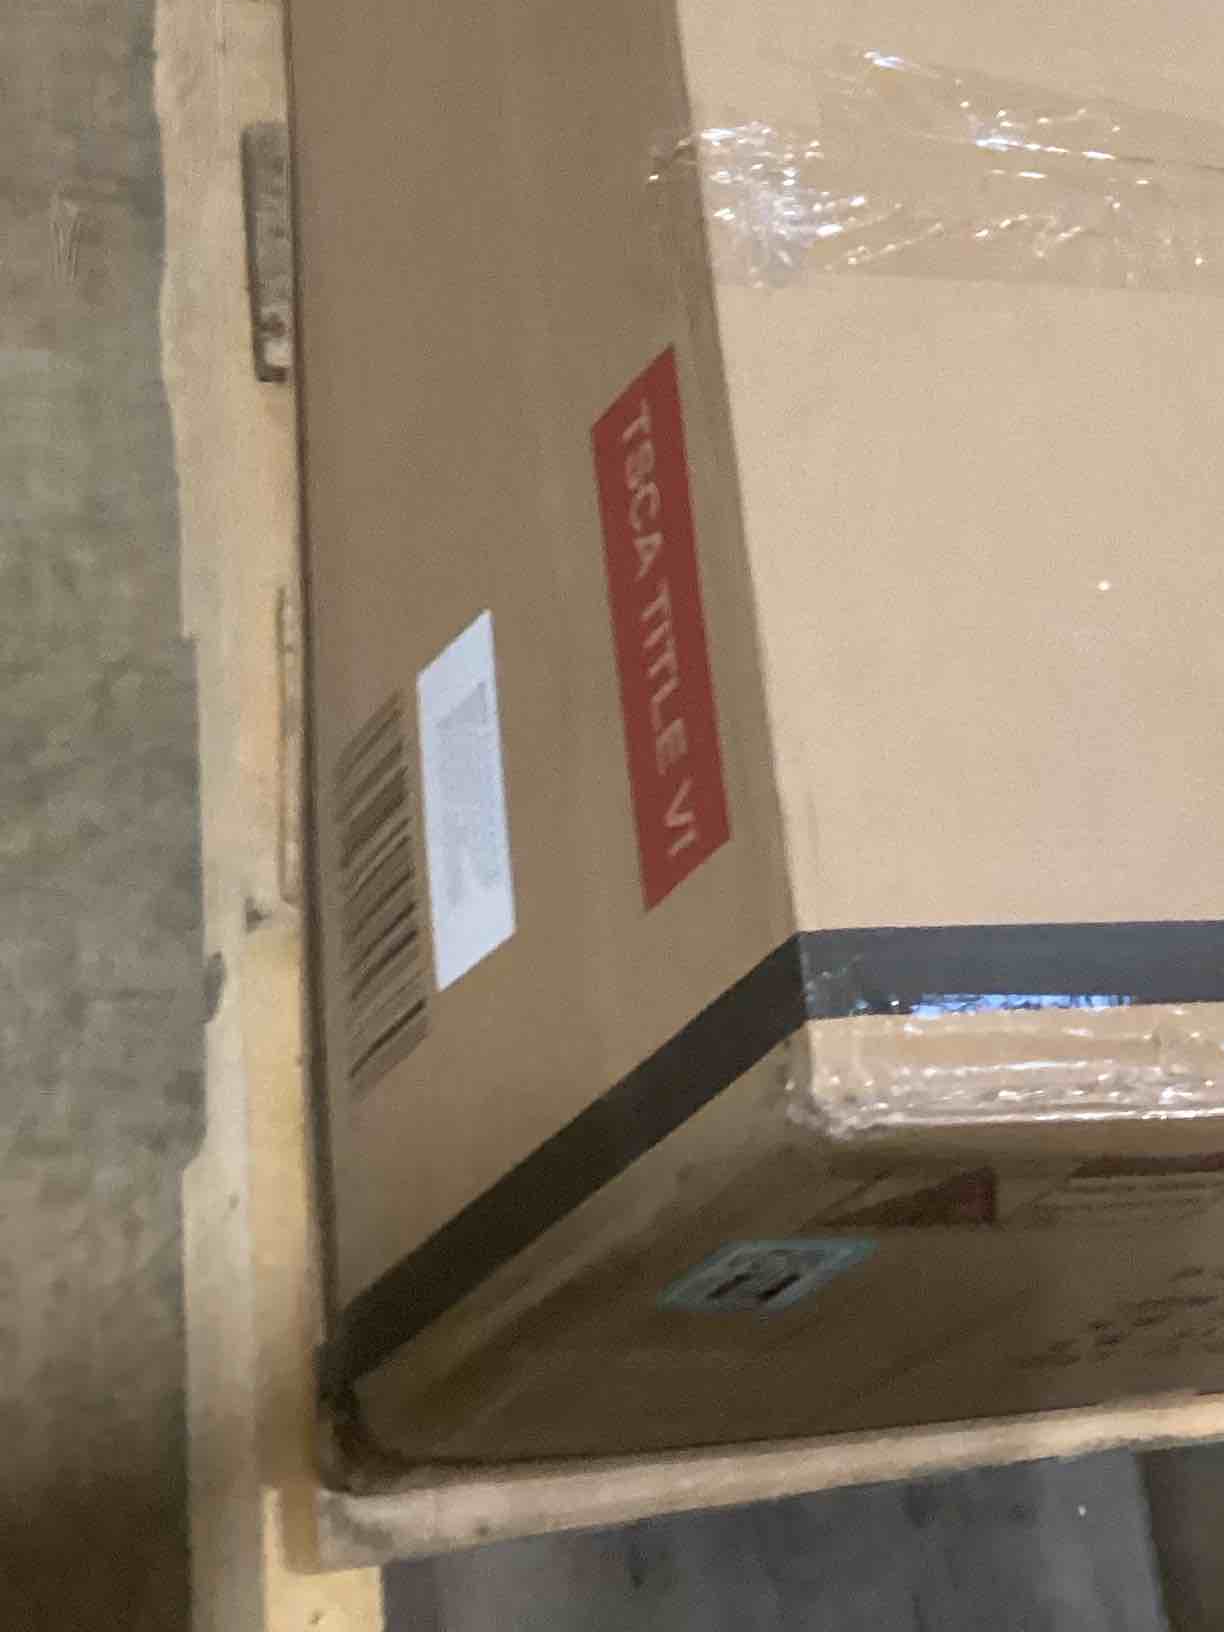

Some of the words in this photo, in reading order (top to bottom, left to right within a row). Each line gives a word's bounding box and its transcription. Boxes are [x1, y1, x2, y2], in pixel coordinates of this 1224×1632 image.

[621, 398, 664, 581] TSCA
[640, 576, 689, 775] TITLE
[664, 778, 698, 858] VI
